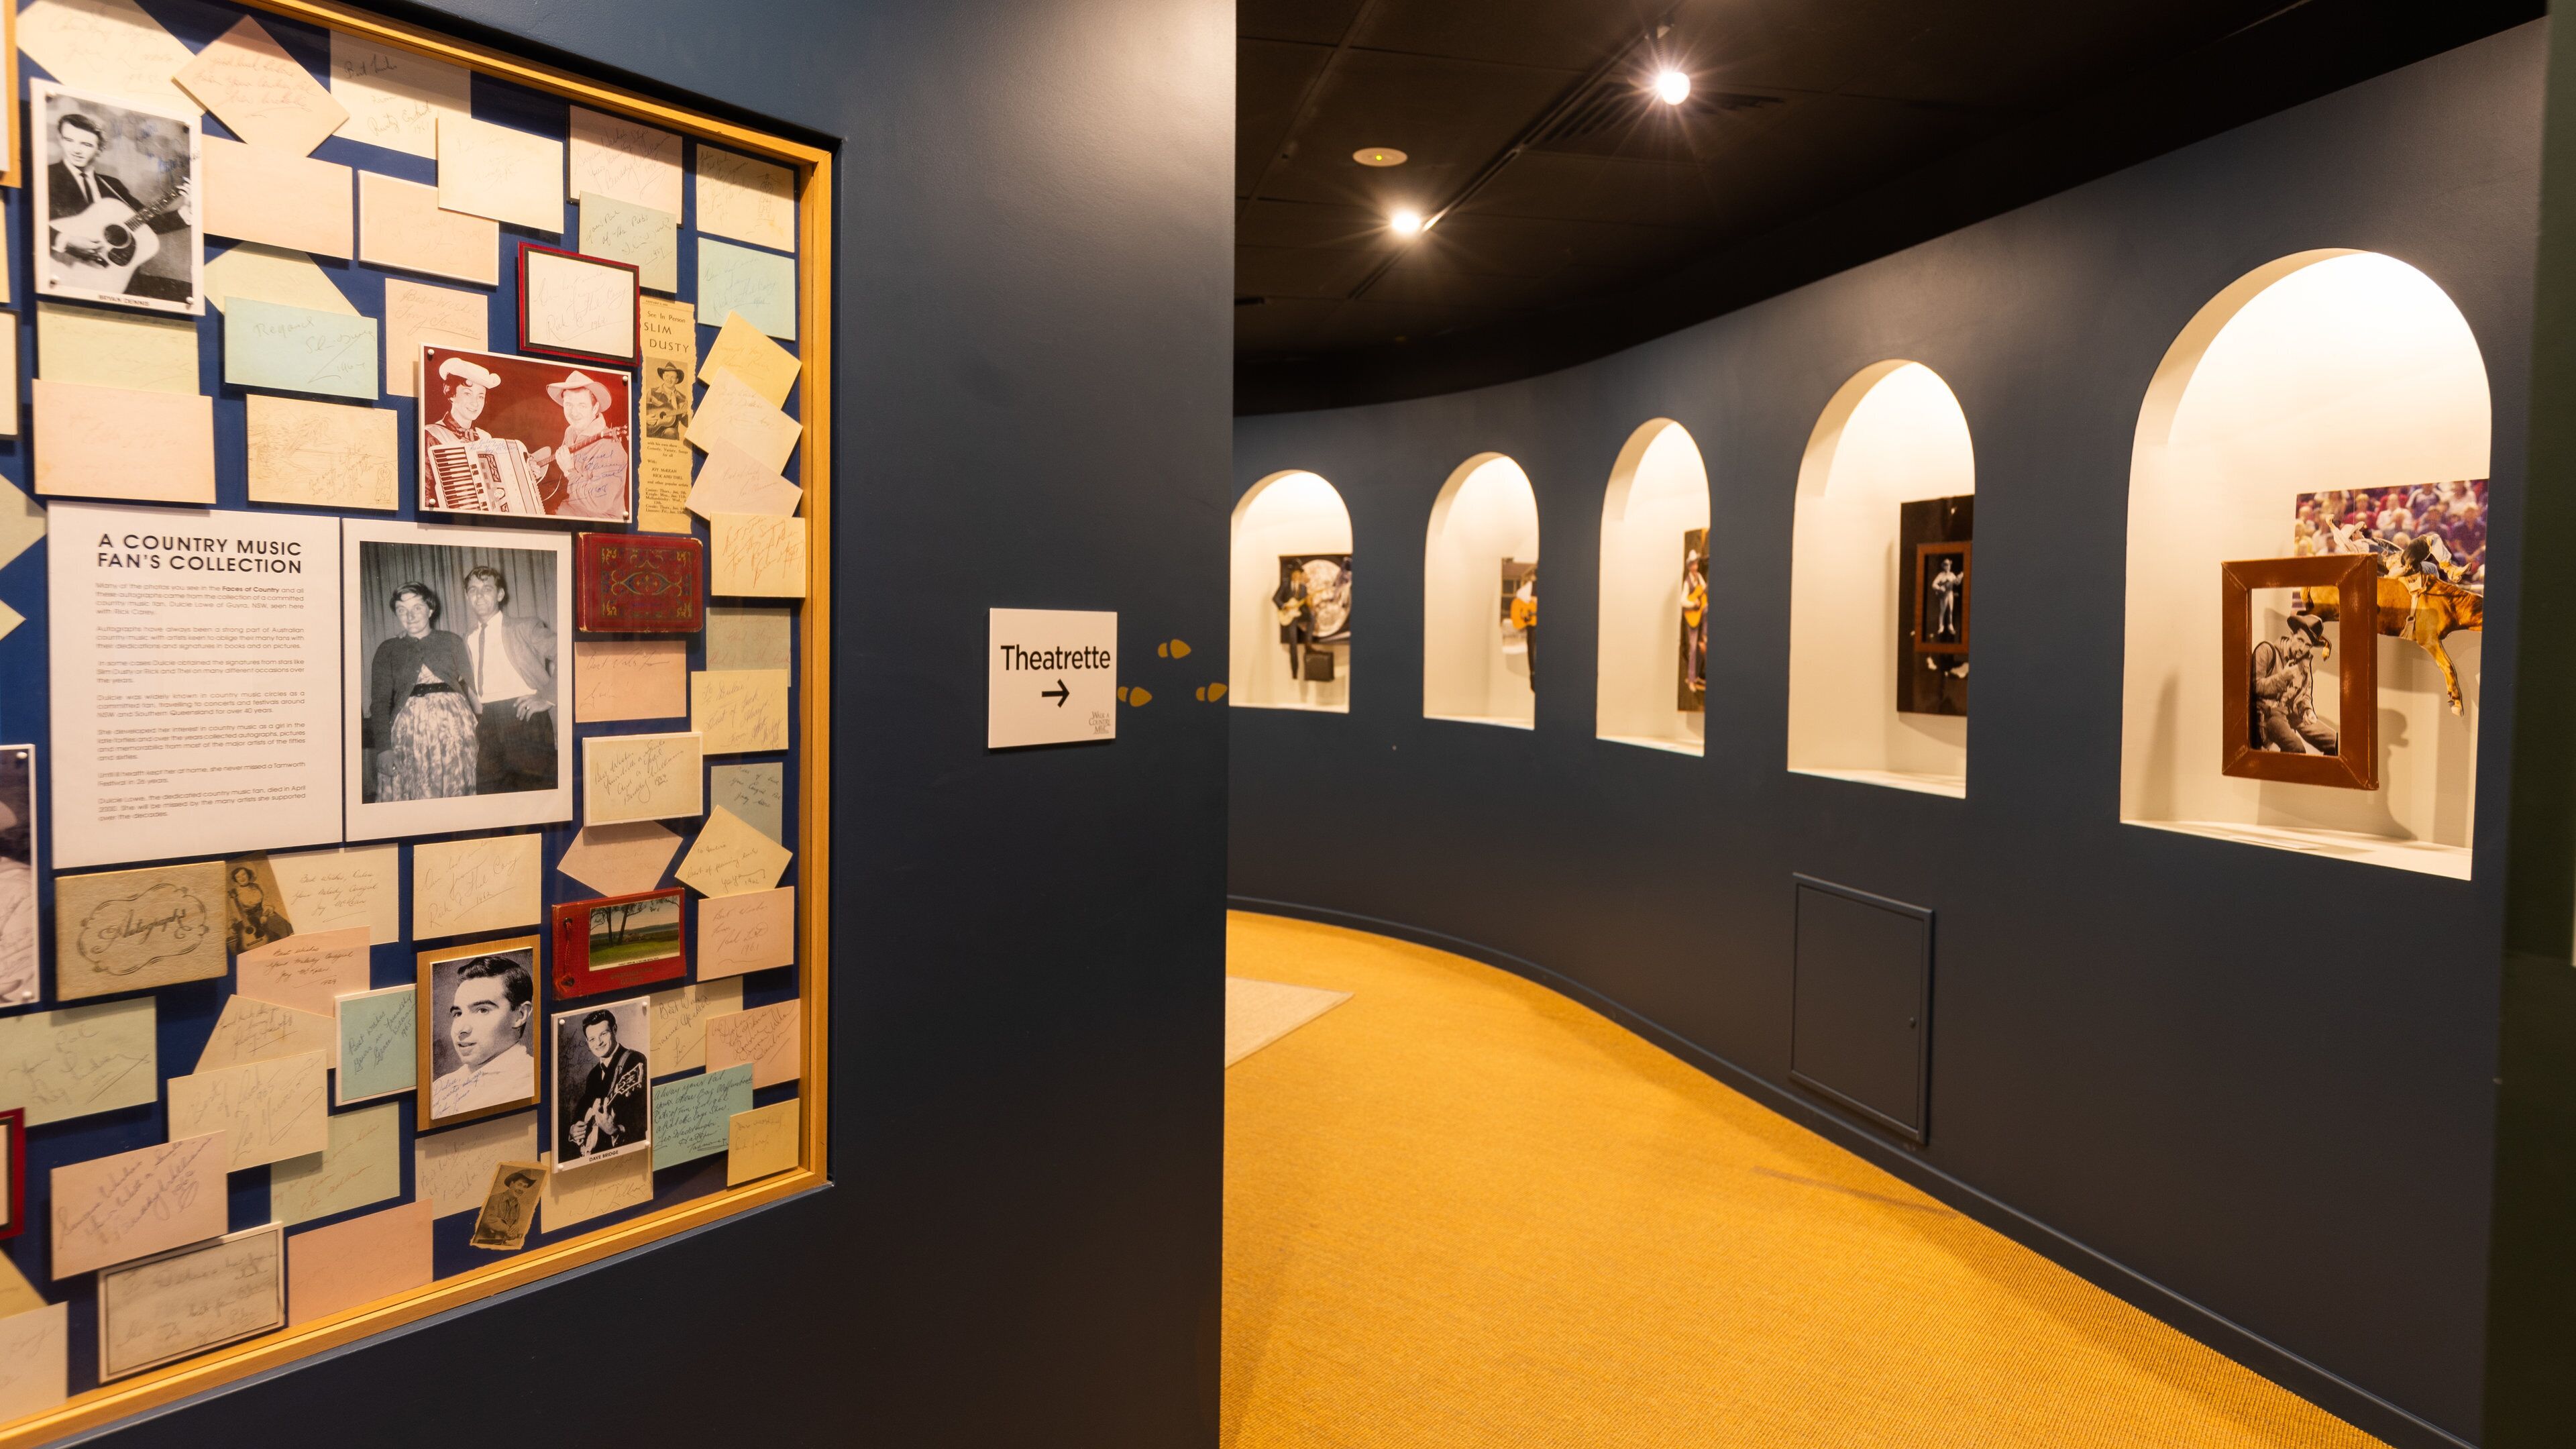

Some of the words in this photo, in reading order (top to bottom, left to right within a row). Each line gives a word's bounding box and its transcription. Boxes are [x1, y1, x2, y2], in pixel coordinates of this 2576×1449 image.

[123, 297, 150, 307] DENNIS
[647, 311, 657, 319] See
[668, 314, 686, 323] Person
[644, 321, 672, 335] SLIM
[649, 338, 689, 354] DUSTY
[97, 533, 114, 548] A
[123, 534, 228, 553] COUNTRY
[237, 540, 302, 555] MUSIC
[97, 552, 161, 570] FAN'S
[169, 555, 302, 574] COLLECTION
[1000, 644, 1111, 671] Theatrette
[1088, 718, 1111, 727] COUNTRY
[602, 1150, 619, 1159] BRIDGE
